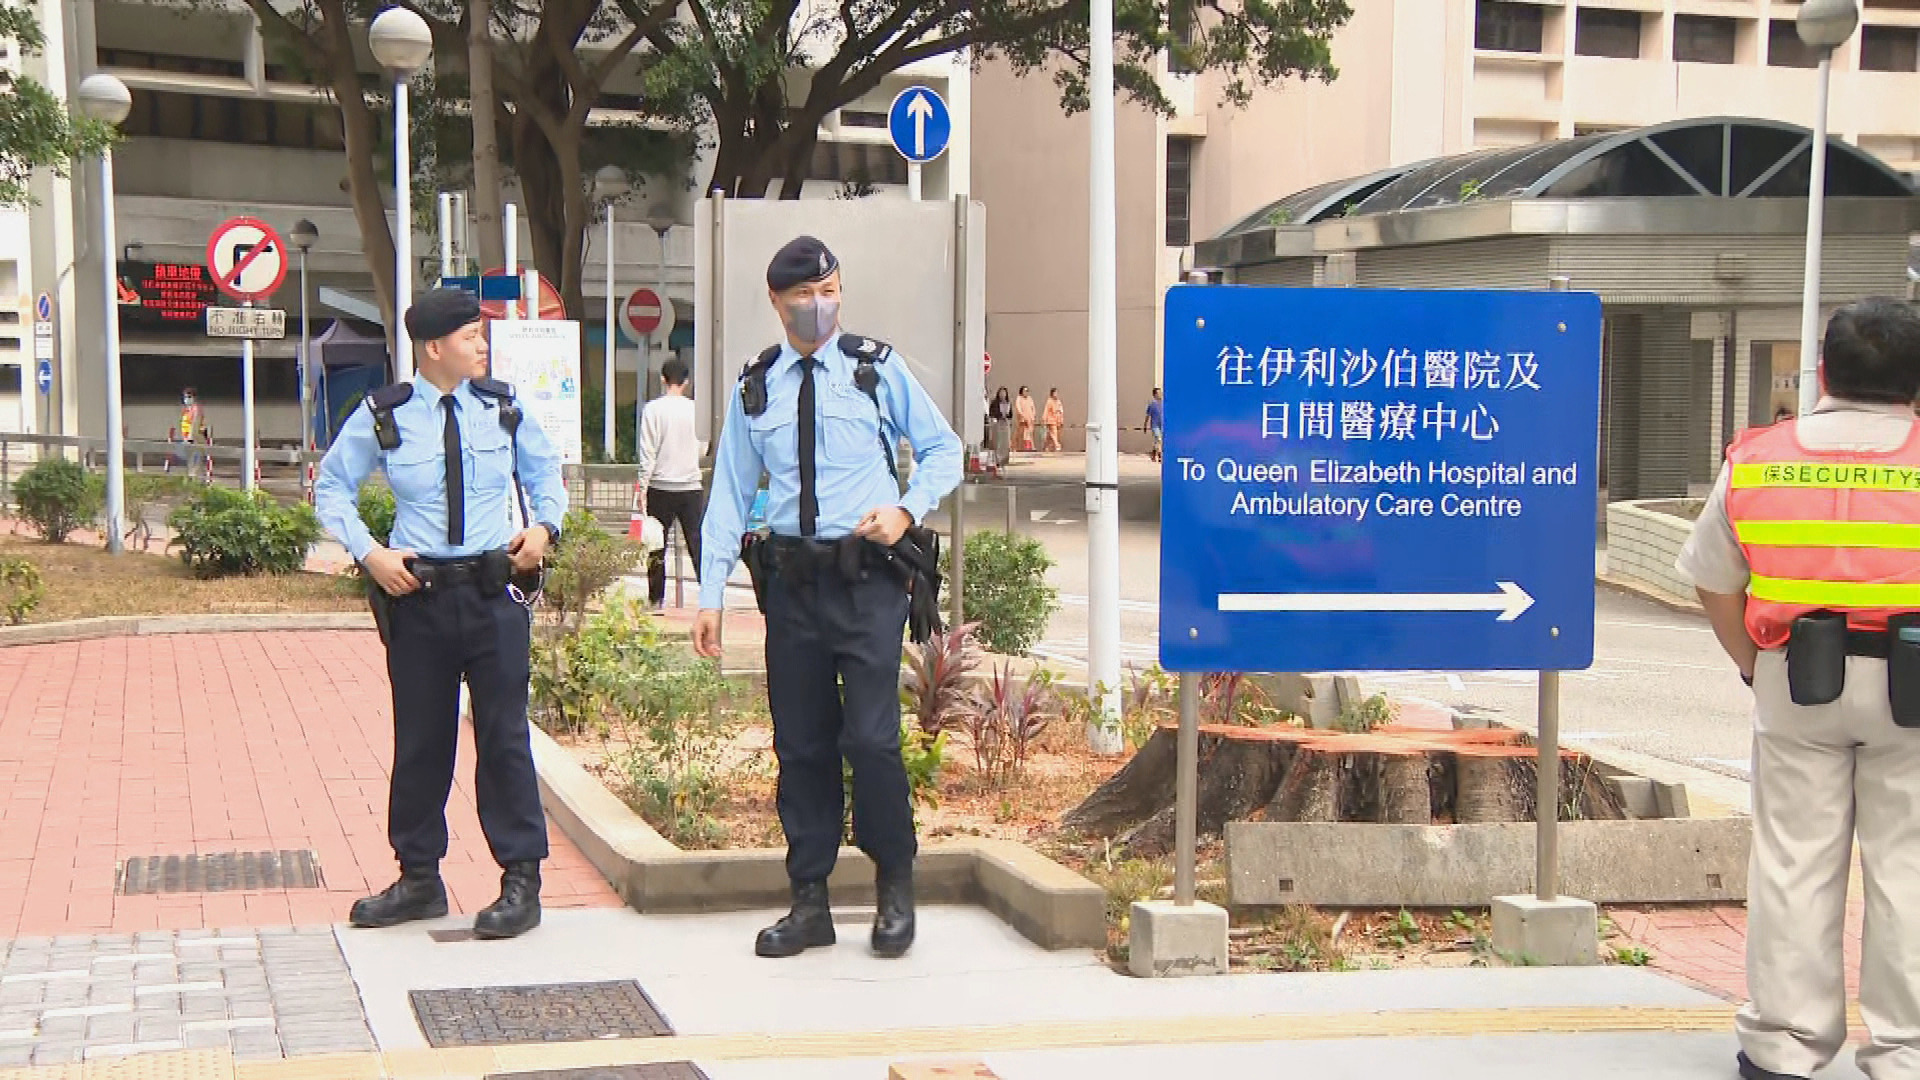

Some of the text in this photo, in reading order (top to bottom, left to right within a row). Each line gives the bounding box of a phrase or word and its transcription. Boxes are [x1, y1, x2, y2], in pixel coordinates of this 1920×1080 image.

[210, 325, 284, 337] NO RIGHT TURN
[1216, 346, 1541, 390] 往伊利沙伯醫院及
[1262, 401, 1499, 440] 日間醫療中心
[1177, 458, 1576, 488] To Queen Elizabeth Hospital and
[1231, 492, 1521, 521] Ambulatory Care Centre
